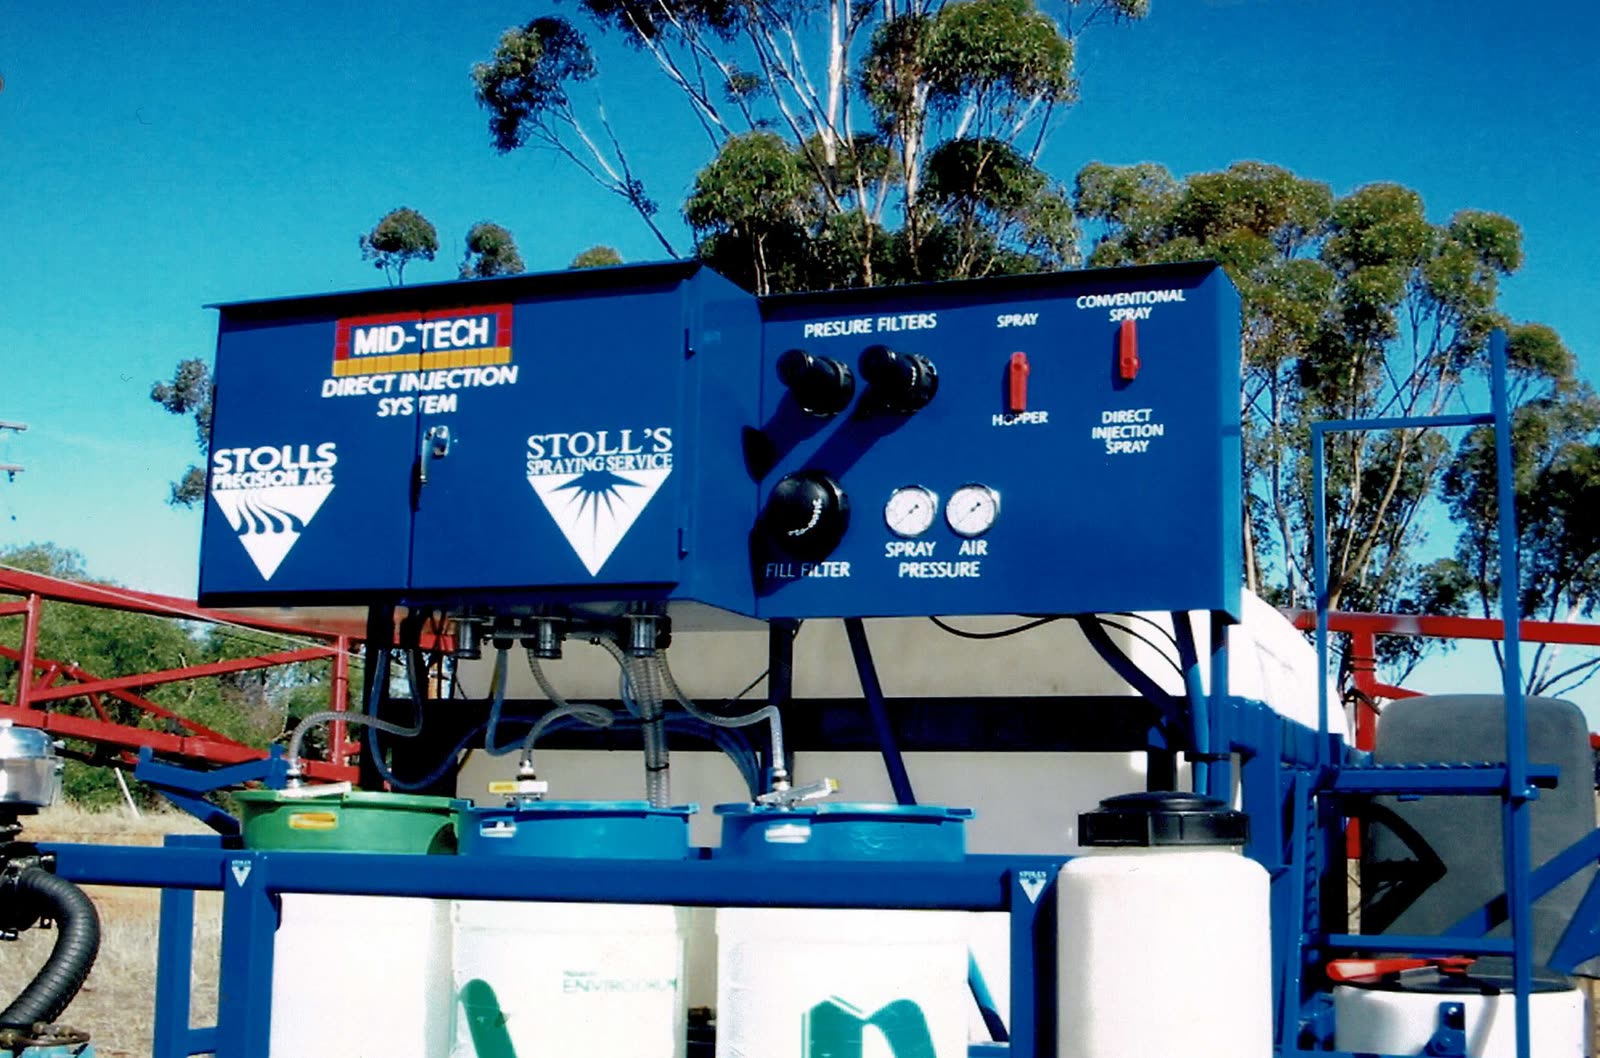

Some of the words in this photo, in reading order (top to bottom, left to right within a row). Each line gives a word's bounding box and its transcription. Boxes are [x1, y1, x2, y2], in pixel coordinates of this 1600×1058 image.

[1076, 289, 1186, 309] CONVENTIONAL
[997, 313, 1039, 328] SPRAY
[1109, 307, 1152, 322] SPRAY
[804, 318, 872, 338] PRESURE
[877, 313, 937, 332] FILTERS
[354, 317, 489, 355] MID-TECH
[321, 373, 396, 398] DIRECT
[399, 365, 519, 391] INJECTION
[376, 394, 458, 417] SYSTEM
[1102, 408, 1152, 424] DIRECT
[1092, 424, 1164, 440] INJECTION
[526, 427, 673, 460] STOLL'S
[1106, 440, 1149, 454] SPRAY
[213, 442, 338, 474] STOLLS
[526, 455, 605, 475] SPRAYING
[606, 453, 673, 472] SERVICE
[212, 469, 300, 490] PRECISION
[303, 467, 334, 485] AG
[885, 541, 936, 557] SPRAY
[958, 540, 988, 555] AIR
[766, 563, 795, 577] FILL
[801, 561, 850, 577] FILTER
[898, 561, 981, 578] PRESSURE
